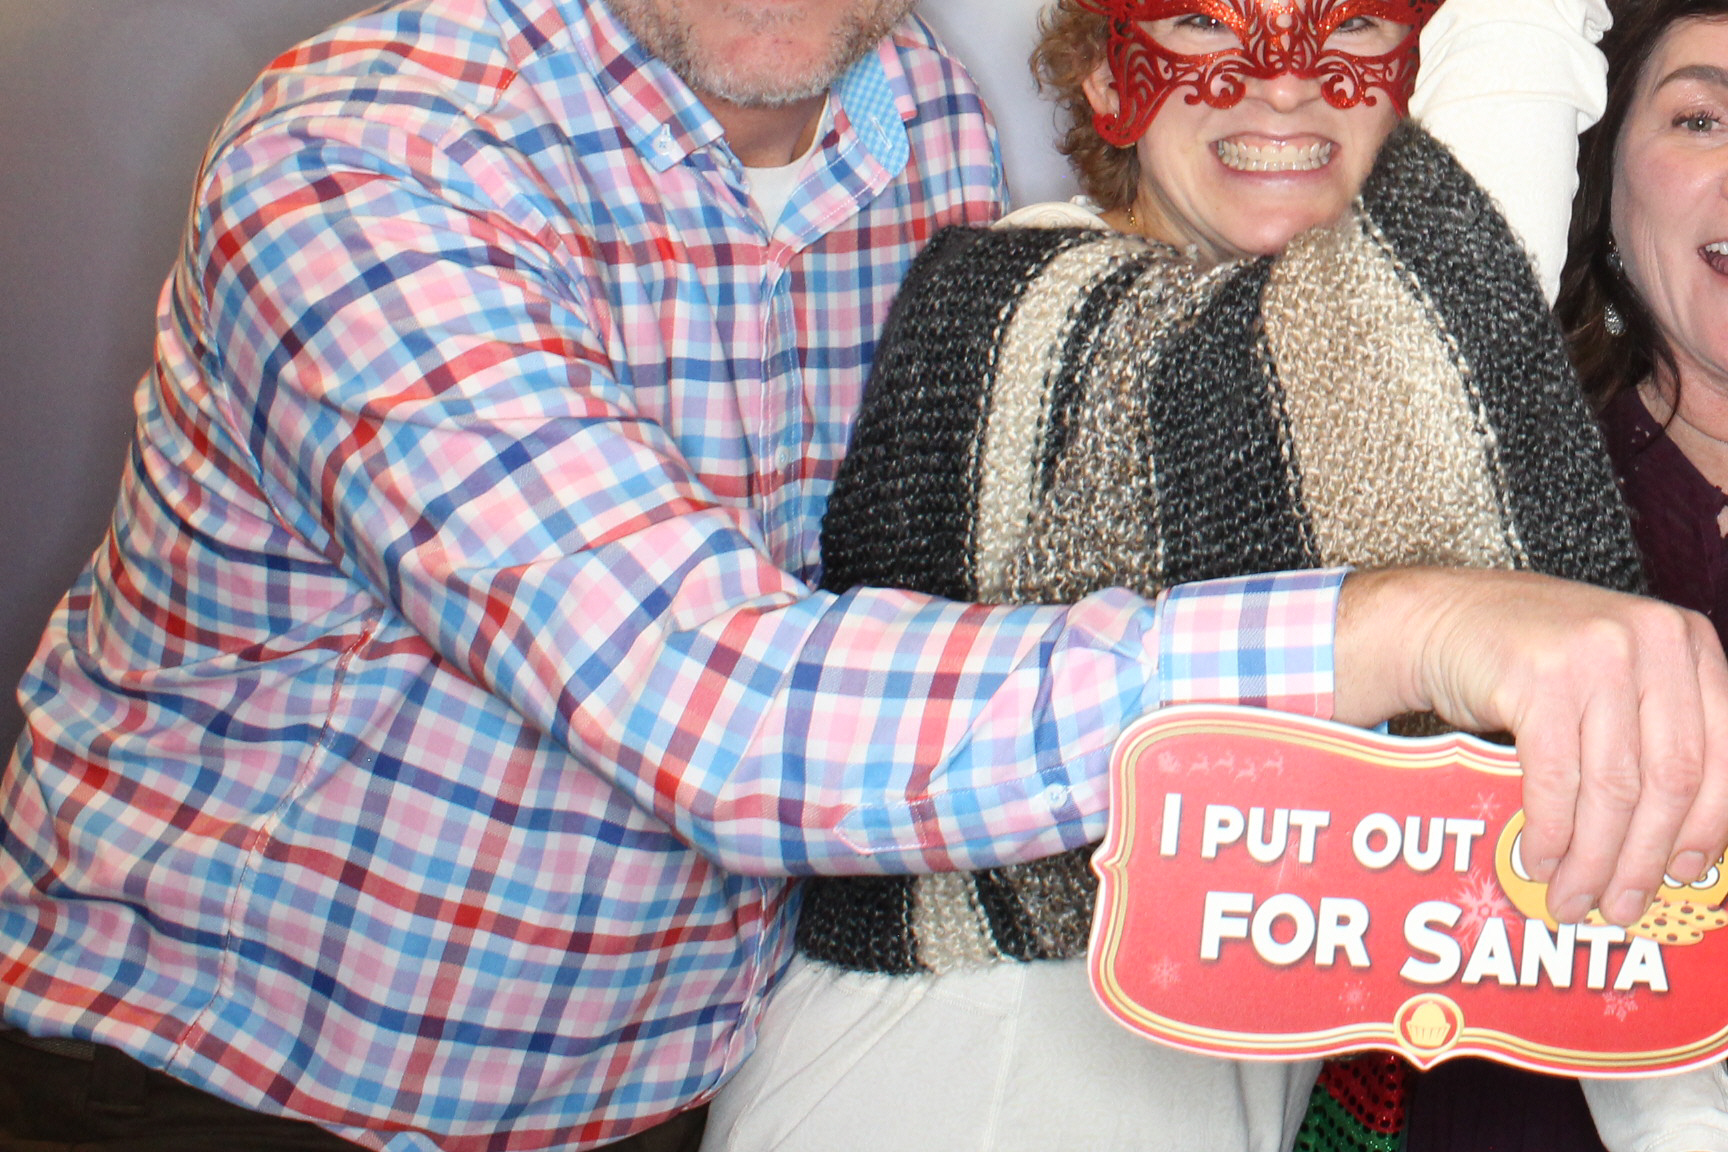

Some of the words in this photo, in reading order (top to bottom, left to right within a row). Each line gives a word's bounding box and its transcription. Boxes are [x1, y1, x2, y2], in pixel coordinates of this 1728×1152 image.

[1159, 793, 1182, 857] I
[1200, 803, 1330, 864] PUT
[1352, 812, 1485, 872] OUT
[1199, 891, 1371, 968] FOR
[1399, 900, 1669, 992] SANTA
